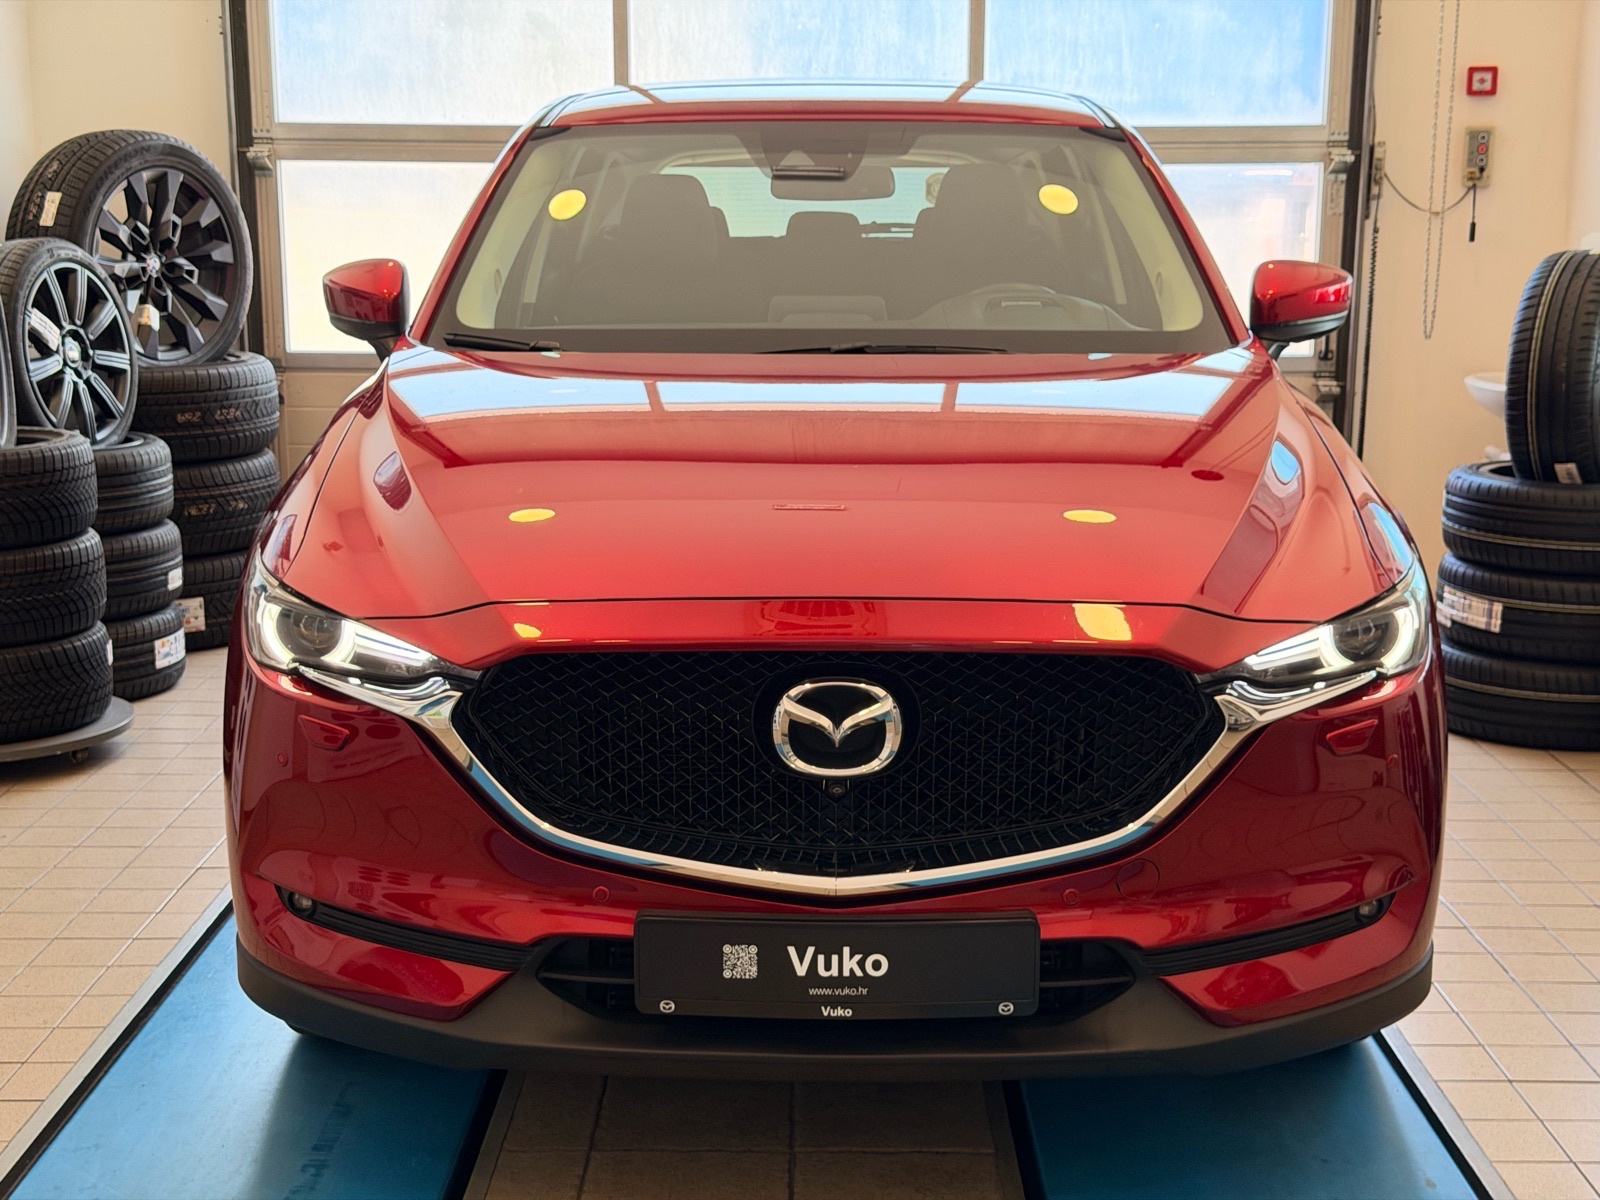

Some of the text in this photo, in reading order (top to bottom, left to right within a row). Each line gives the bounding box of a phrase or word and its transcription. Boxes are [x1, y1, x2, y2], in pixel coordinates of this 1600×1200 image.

[787, 945, 889, 977] Vuko
[808, 986, 868, 996] www.vuko.hr
[821, 1006, 853, 1017] Vuko
